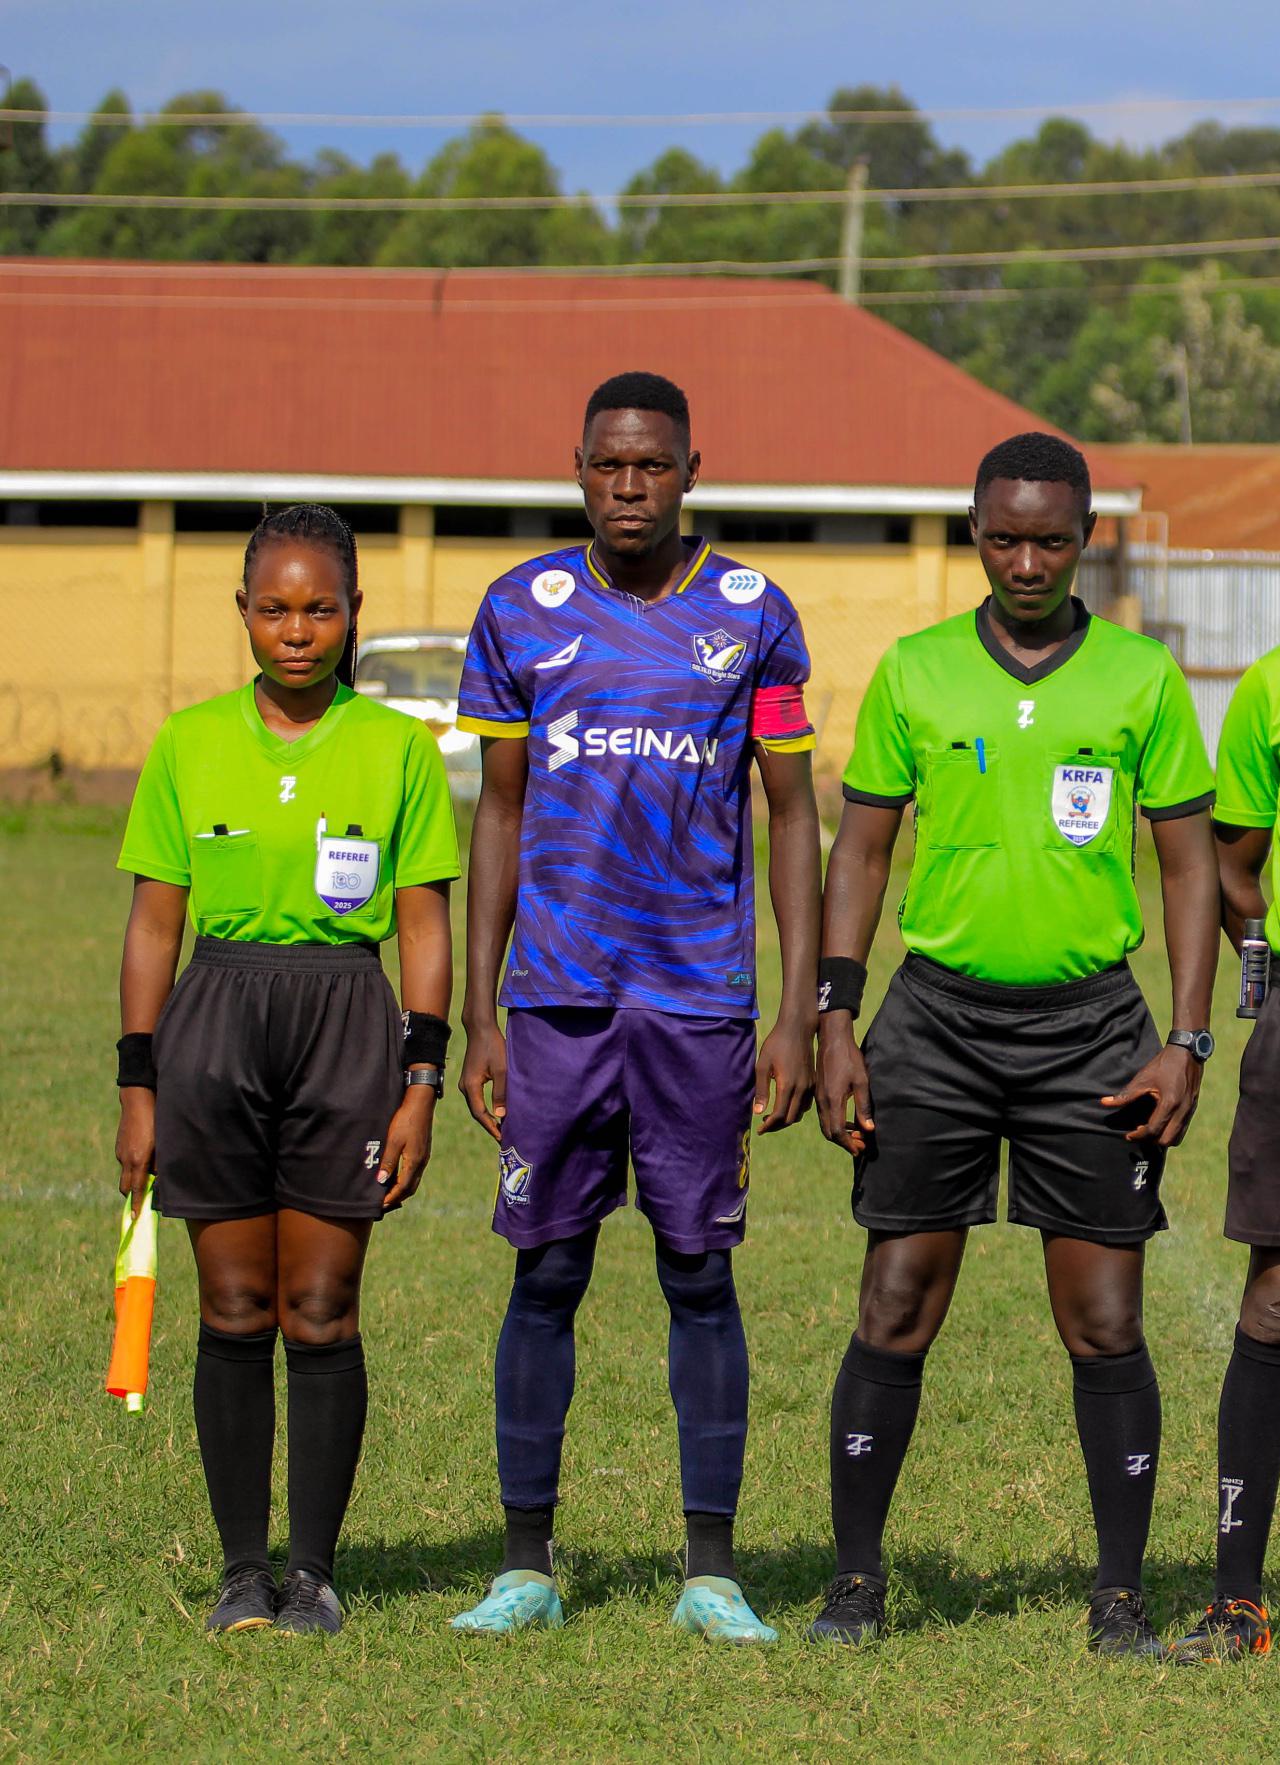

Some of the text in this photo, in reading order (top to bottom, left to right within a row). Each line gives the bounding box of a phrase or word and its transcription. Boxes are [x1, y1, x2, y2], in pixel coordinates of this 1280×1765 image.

[584, 726, 719, 767] SEINAN
[1062, 769, 1104, 784] KRFA
[1058, 818, 1100, 831] REFEREE
[328, 850, 370, 863] REFEREE
[333, 901, 353, 910] 2025
